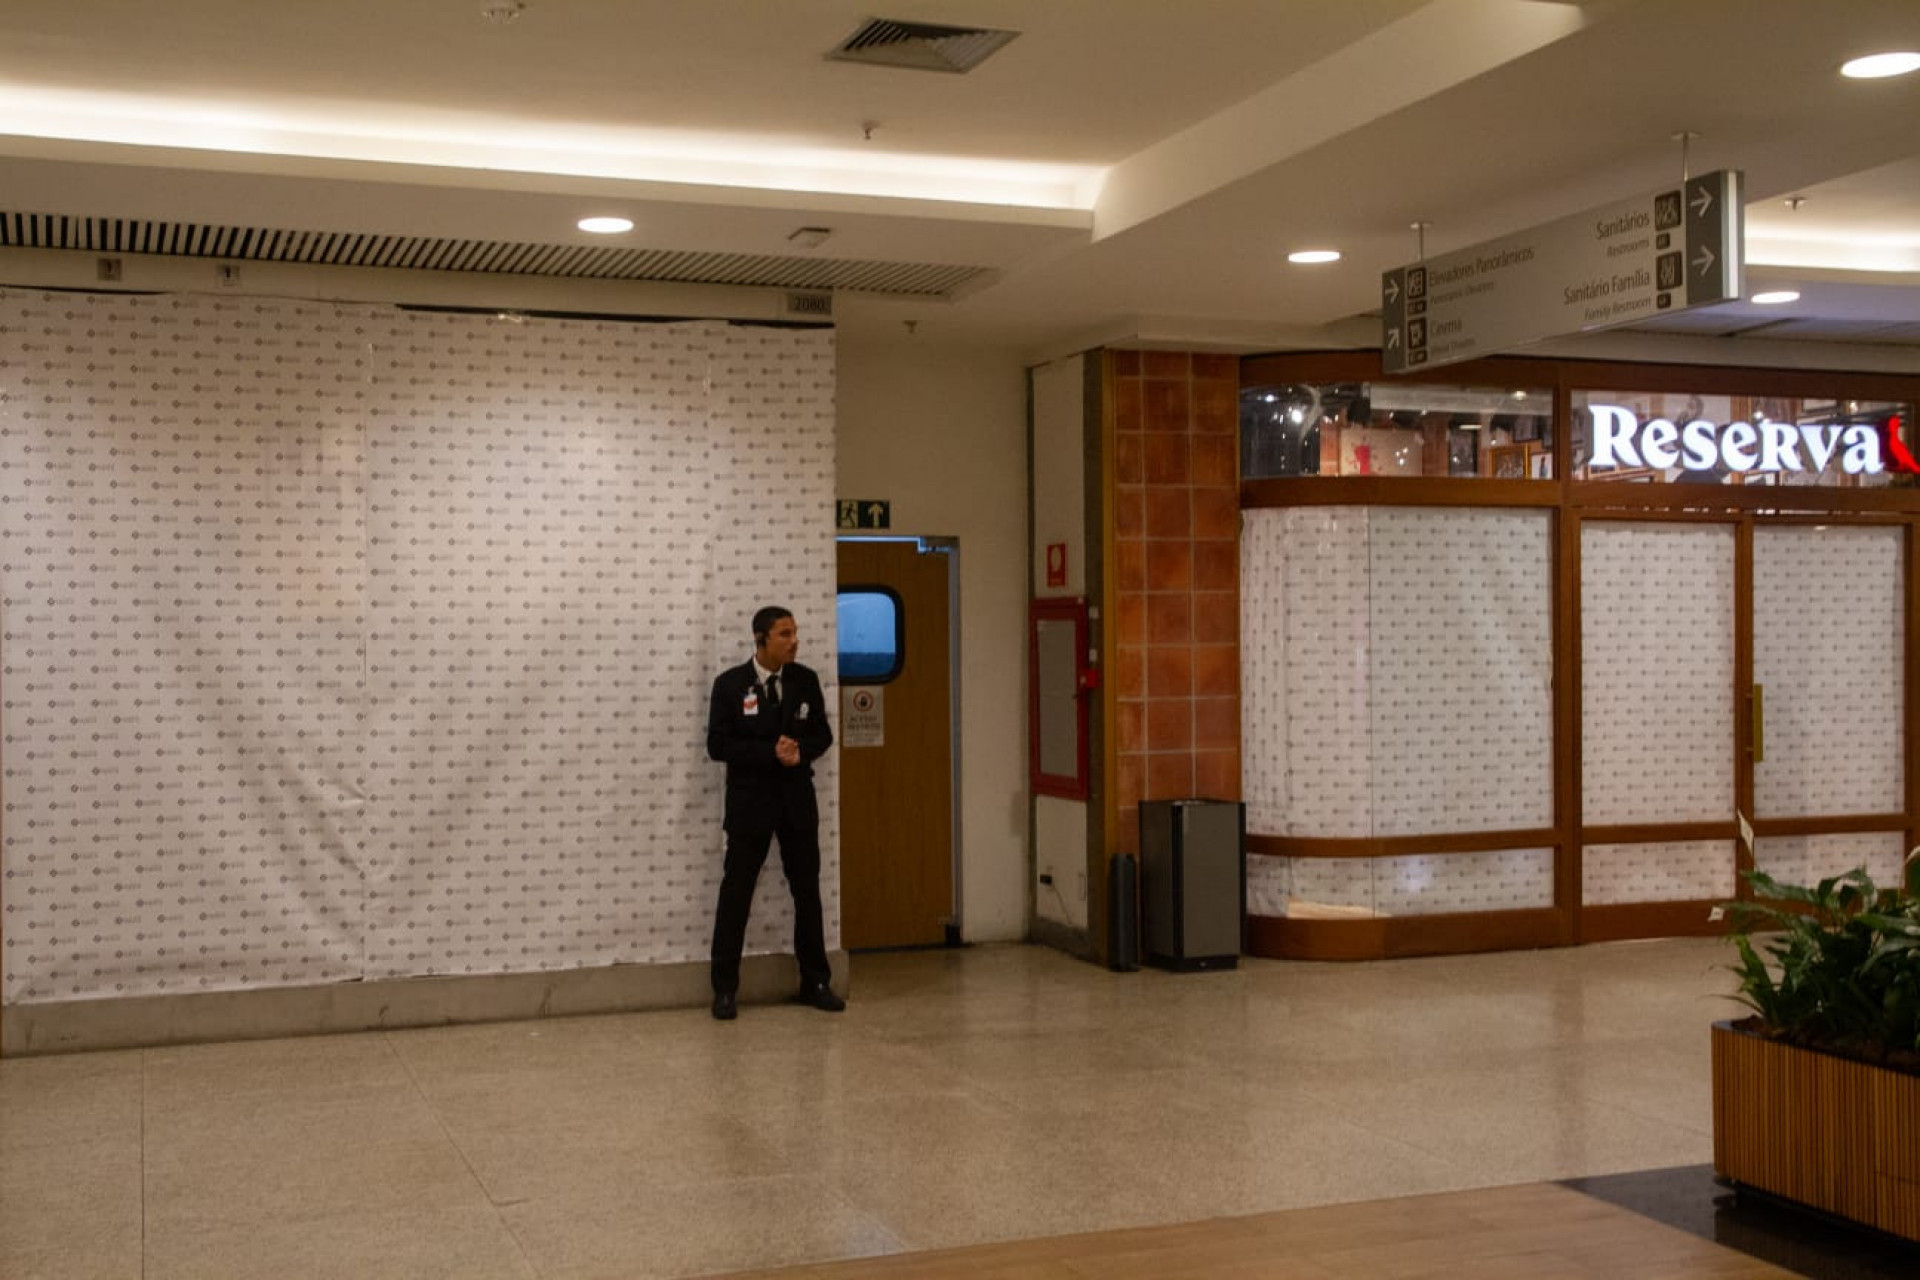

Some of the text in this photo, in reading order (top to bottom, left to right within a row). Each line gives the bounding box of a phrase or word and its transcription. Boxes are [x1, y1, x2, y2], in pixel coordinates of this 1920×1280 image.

[1596, 212, 1650, 240] Sanitários
[1476, 247, 1534, 274] Panorâmicos
[1564, 268, 1650, 305] Sanitário Família
[1588, 404, 1885, 474] Reserva
